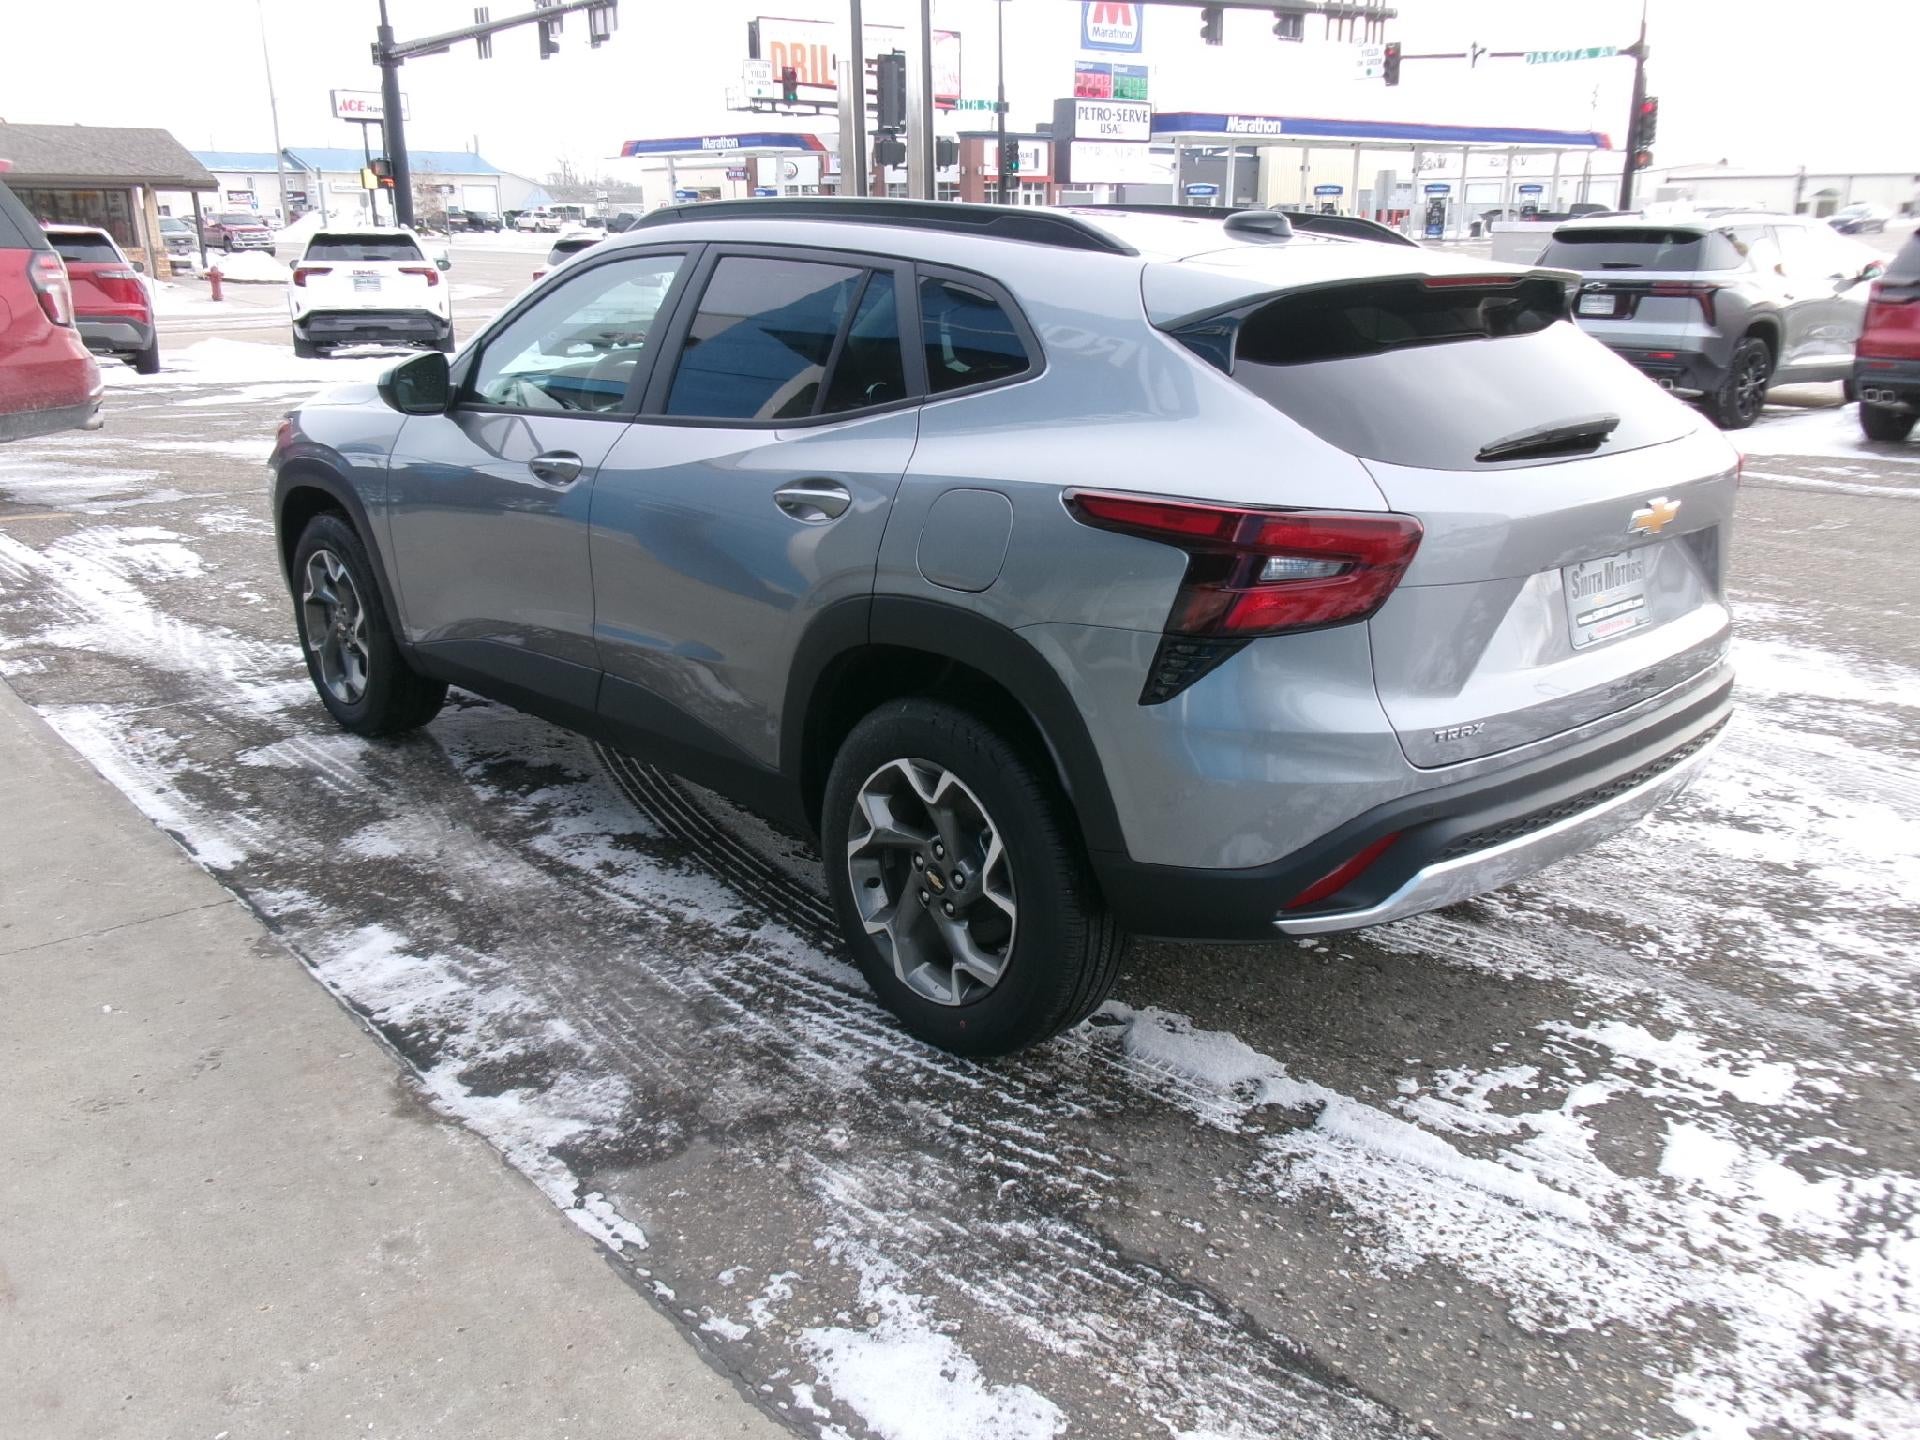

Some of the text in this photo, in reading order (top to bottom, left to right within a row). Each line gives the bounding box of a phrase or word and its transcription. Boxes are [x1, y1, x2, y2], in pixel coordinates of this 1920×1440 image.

[1092, 26, 1133, 39] Marathon
[1526, 48, 1589, 64] DAKOTA
[339, 98, 365, 112] ACE
[956, 100, 979, 110] 11TH
[1078, 106, 1149, 123] PETRO-SERVE
[1100, 123, 1118, 134] USA
[1226, 116, 1281, 133] Marathon
[702, 136, 739, 150] Marathon
[1432, 722, 1486, 743] TRAX
